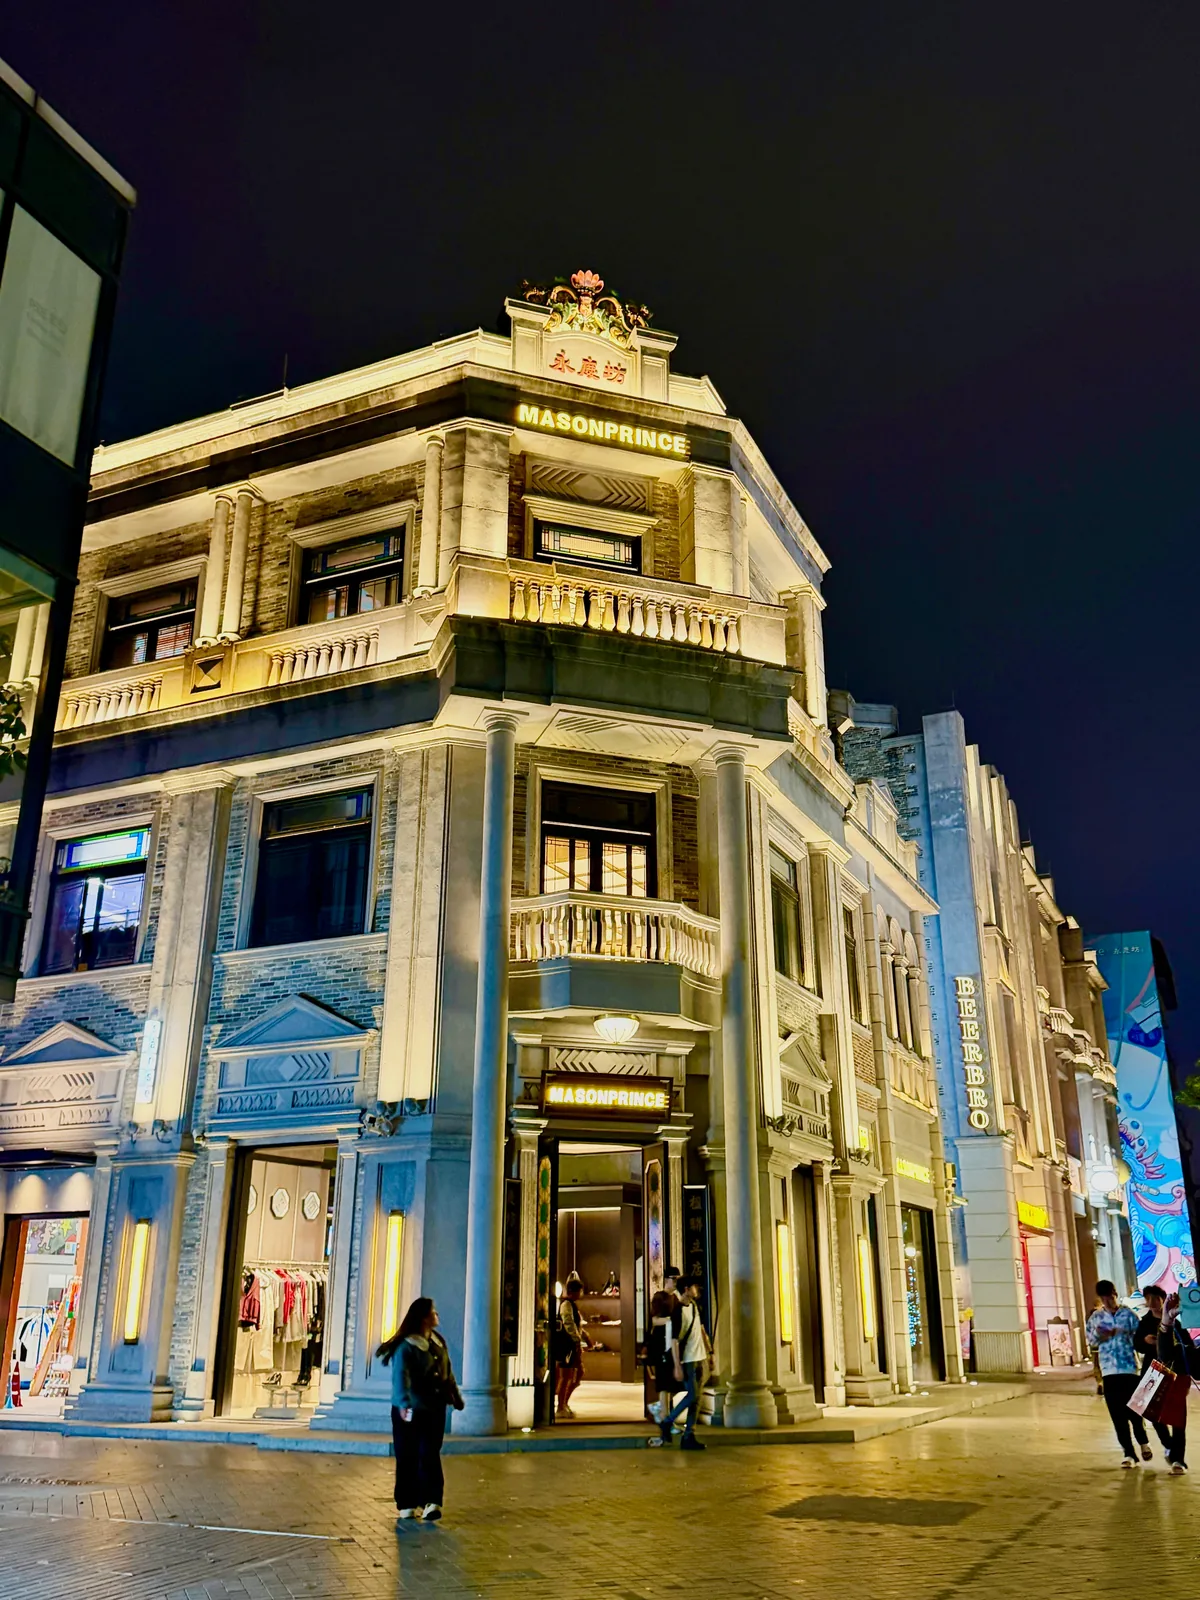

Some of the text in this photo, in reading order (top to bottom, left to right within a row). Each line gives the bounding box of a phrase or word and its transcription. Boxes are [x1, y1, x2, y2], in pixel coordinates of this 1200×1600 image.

[518, 404, 687, 455] MASONPRINCE
[955, 976, 990, 1129] BEERBRO
[549, 1086, 666, 1107] MASONPRINCE
